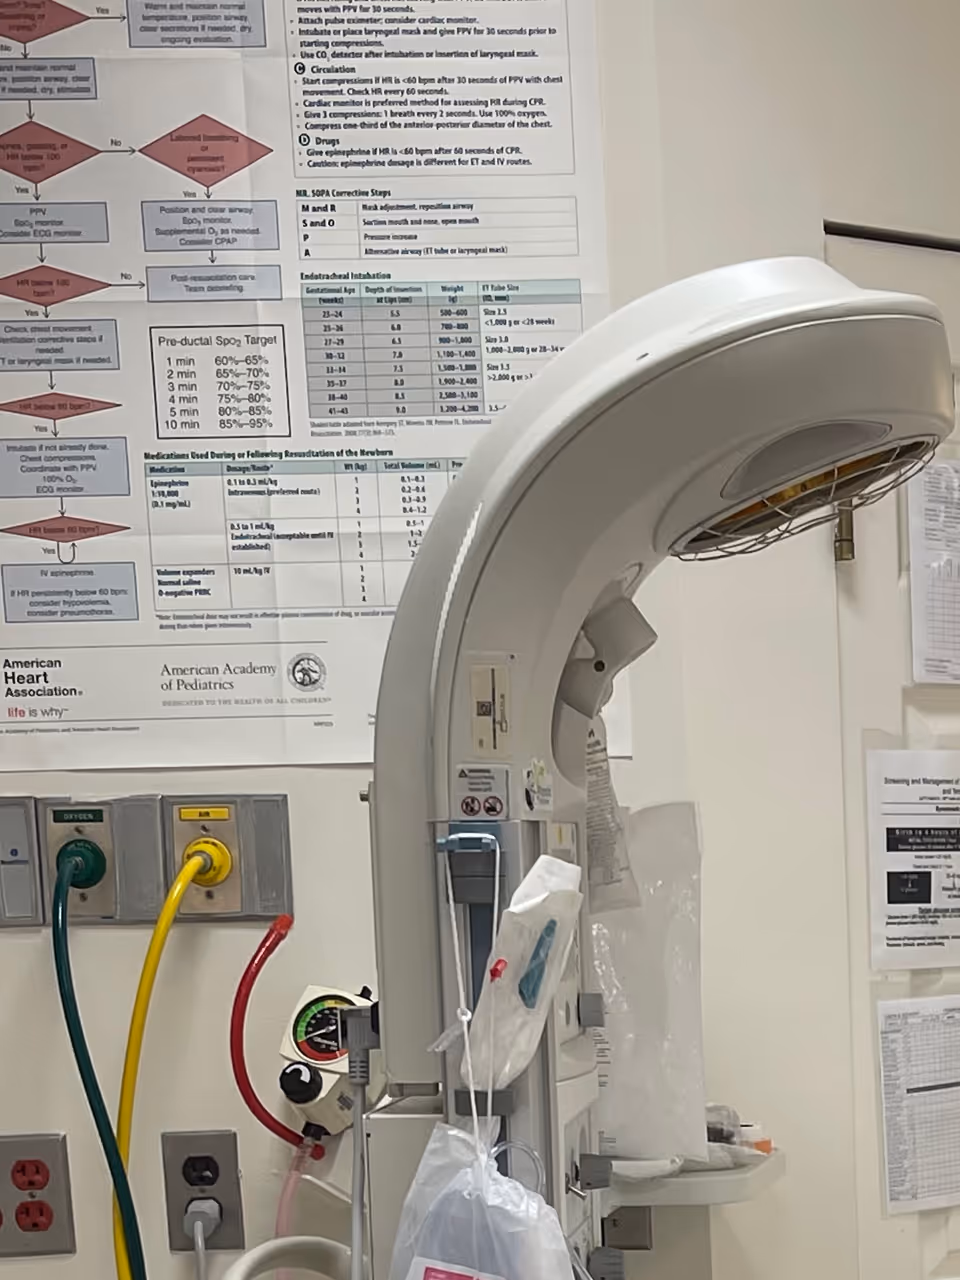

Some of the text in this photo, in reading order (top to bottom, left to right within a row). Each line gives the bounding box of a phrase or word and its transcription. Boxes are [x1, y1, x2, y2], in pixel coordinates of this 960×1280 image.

[437, 76, 455, 84] after
[468, 76, 498, 84] seconds
[499, 76, 507, 84] of
[373, 98, 408, 108] preferred
[410, 98, 439, 106] method
[441, 98, 451, 106] for
[454, 98, 488, 108] assessing
[503, 98, 527, 108] during
[417, 111, 437, 119] every
[305, 122, 341, 130] Compress
[380, 121, 388, 129] of
[316, 137, 339, 146] Drugs
[312, 189, 330, 197] SOPA
[30, 208, 47, 216] PPV
[302, 204, 336, 212] M and R
[310, 219, 326, 227] and
[328, 219, 335, 227] O
[303, 234, 309, 242] P
[304, 249, 310, 257] A
[300, 272, 391, 280] Endotracheal Intubation
[25, 309, 39, 317] Yes
[158, 336, 212, 346] Pre-ductal
[244, 335, 277, 347] Target
[167, 357, 172, 366] 1
[176, 357, 195, 366] min
[167, 370, 174, 379] 2
[177, 370, 196, 378] min
[168, 382, 175, 391] 3
[178, 382, 197, 391] min
[169, 395, 175, 404] 4
[179, 395, 198, 403] min
[170, 408, 176, 417] 5
[180, 407, 199, 416] min
[165, 421, 177, 429] 10
[181, 420, 200, 429] min
[144, 452, 189, 460] Medications
[210, 452, 235, 460] During
[247, 451, 283, 460] Following
[285, 449, 335, 458] Resuscitation
[336, 449, 344, 457] of
[345, 449, 358, 457] the
[3, 658, 62, 669] American
[161, 662, 277, 677] American Academy
[4, 671, 49, 684] Heart
[161, 678, 234, 691] of Pediatrics
[8, 707, 25, 718] life
[29, 707, 38, 717] is
